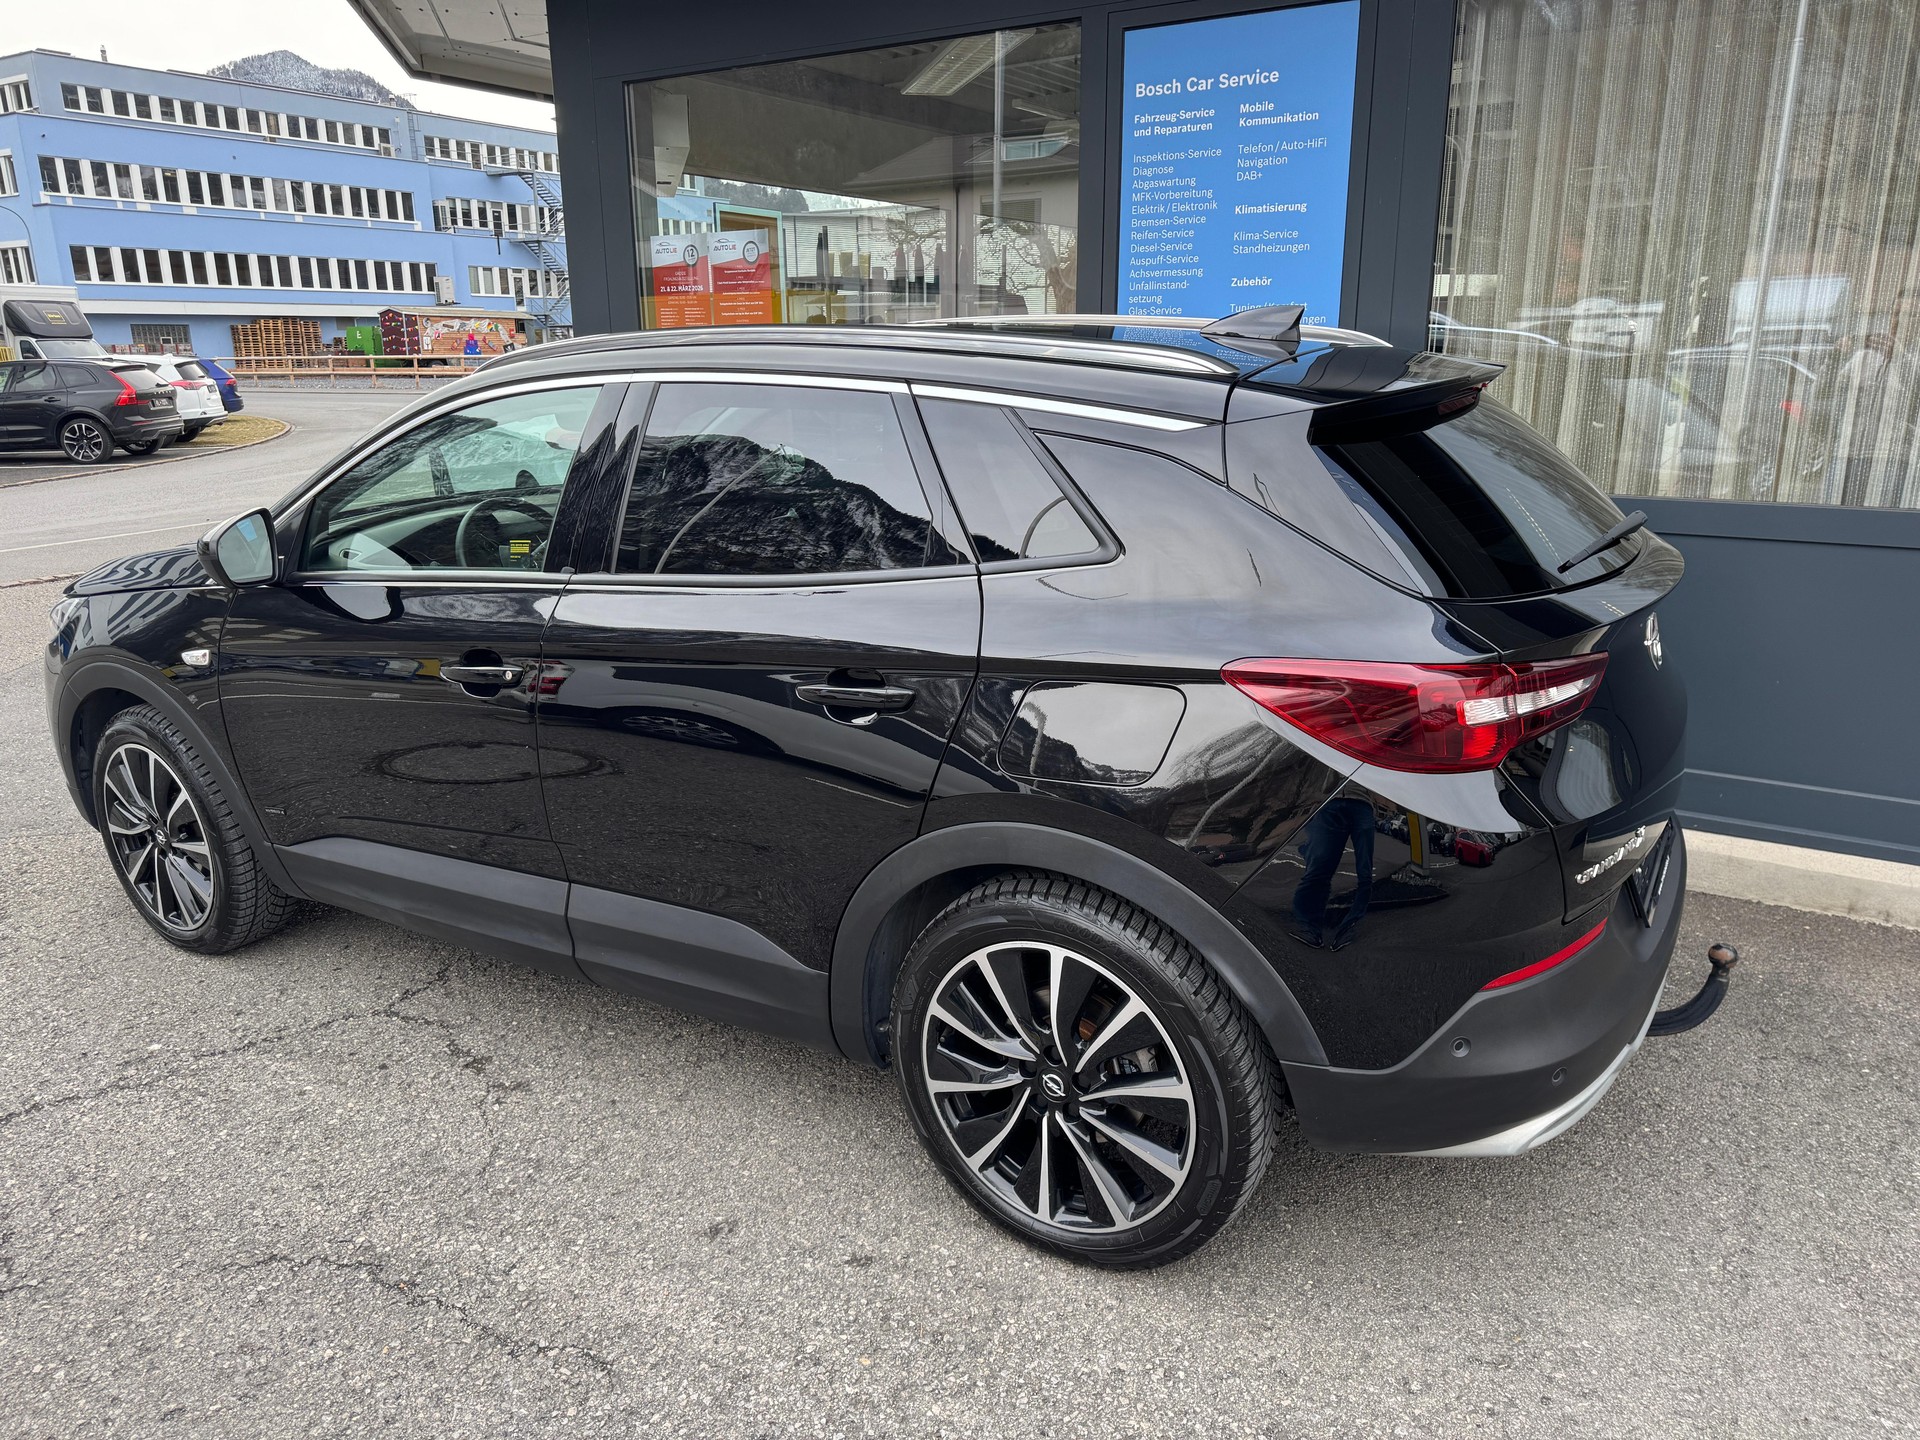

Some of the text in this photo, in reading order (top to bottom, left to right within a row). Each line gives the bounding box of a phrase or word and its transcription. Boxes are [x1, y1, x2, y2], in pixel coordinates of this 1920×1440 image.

[1135, 68, 1280, 98] Bosch Car Service
[1239, 101, 1274, 114] Mobile
[1134, 107, 1215, 124] Fahrzeug-Service
[1239, 111, 1319, 127] Kommunikation
[1133, 122, 1213, 137] und Reparaturen
[1133, 147, 1222, 164] Inspektions-Service
[1237, 155, 1288, 169] Navigation
[1133, 164, 1174, 177] Diagnose
[1236, 171, 1263, 182] DAB+
[1132, 176, 1196, 190] Abgaswartung
[1132, 188, 1213, 202] MFK-Vorbereitung
[1235, 202, 1308, 215] Klimatisierung
[1131, 215, 1206, 228] Bremsen-Service
[1131, 228, 1195, 240] Reifen-Service
[1233, 229, 1299, 241] Klima-Service
[686, 248, 696, 258] 12
[1130, 241, 1193, 254] Diesel-Service
[1233, 242, 1310, 255] Standheizungen
[1129, 254, 1199, 267] Auspuff-Service
[1129, 267, 1203, 279] Achsvermessung
[1129, 280, 1189, 291] Unfallinstand-
[1231, 277, 1272, 287] Zubehör
[1128, 294, 1162, 304] setzung
[1128, 306, 1182, 316] Glas-Service
